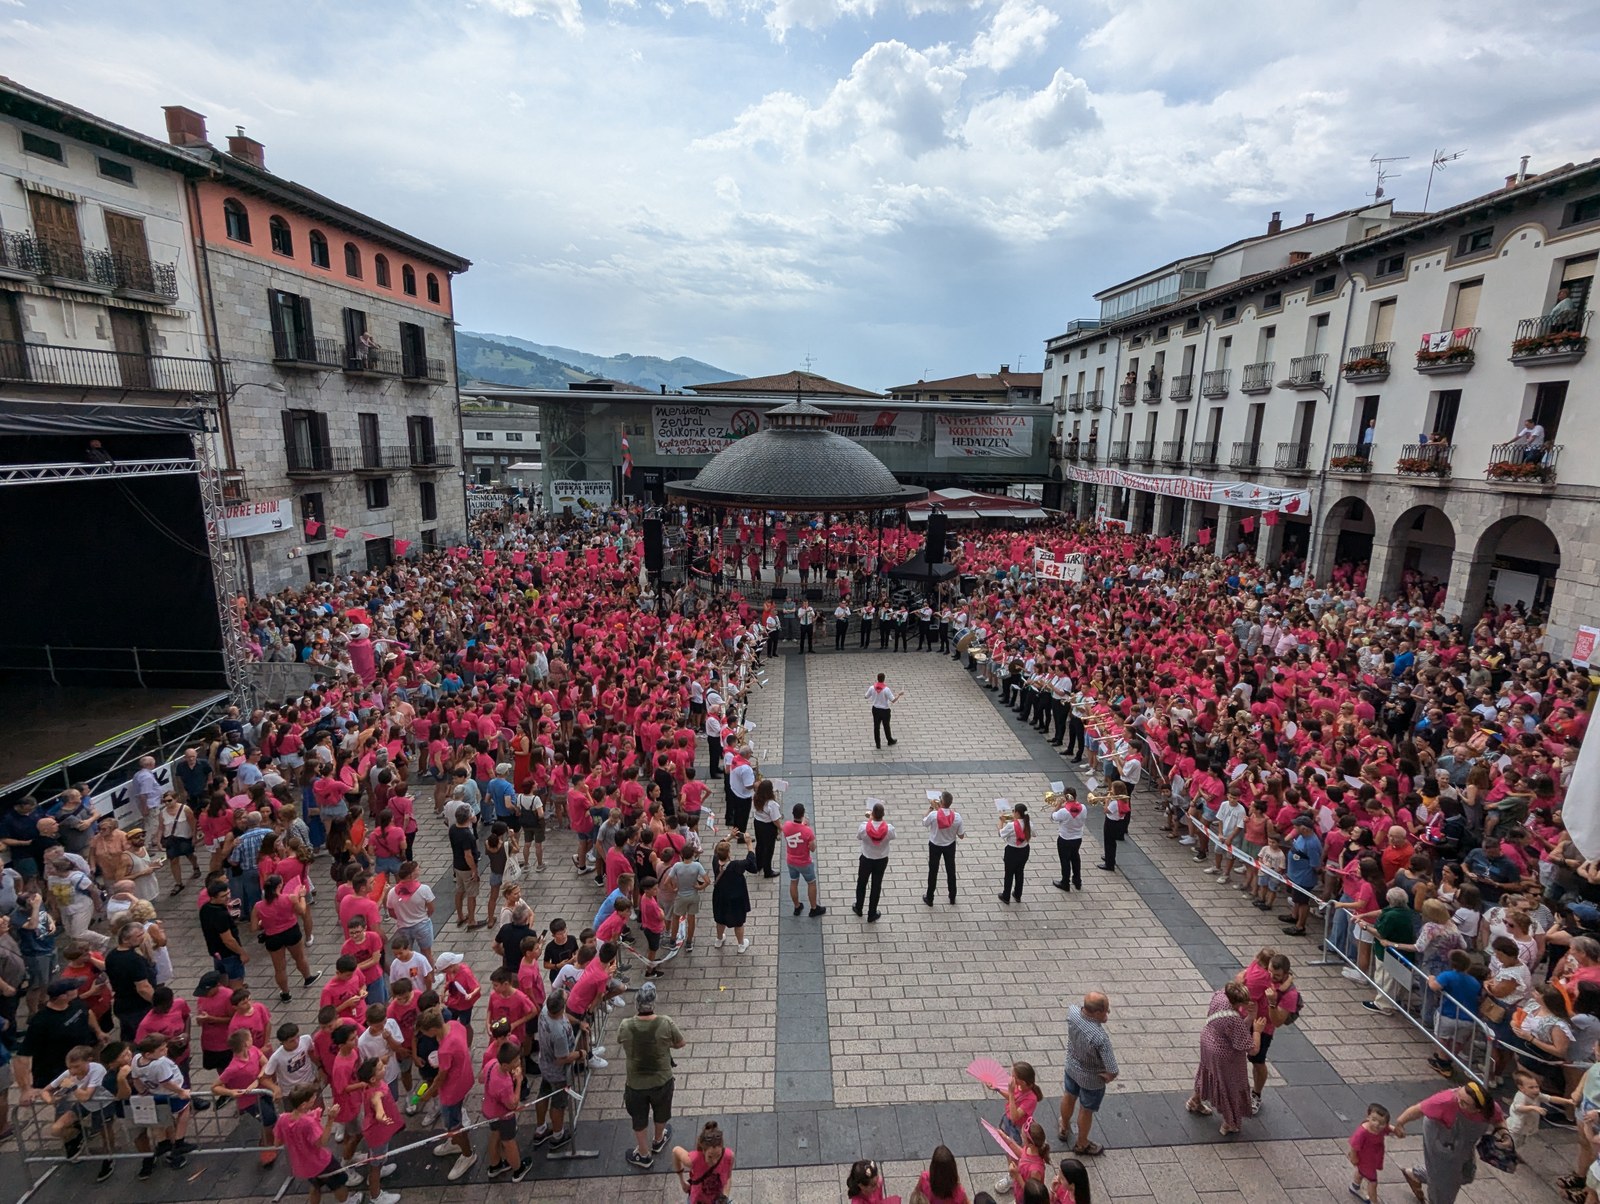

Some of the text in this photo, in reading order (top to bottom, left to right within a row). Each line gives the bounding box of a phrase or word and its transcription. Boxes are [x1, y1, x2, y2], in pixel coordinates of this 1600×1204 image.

[936, 415, 1026, 426] ANTOLAKUNTZA
[949, 426, 1014, 437] KOMUNISTA
[952, 437, 1010, 448] HEDATZEN
[1174, 478, 1213, 500] ERAIKI
[217, 500, 280, 520] AURRE EGIN!
